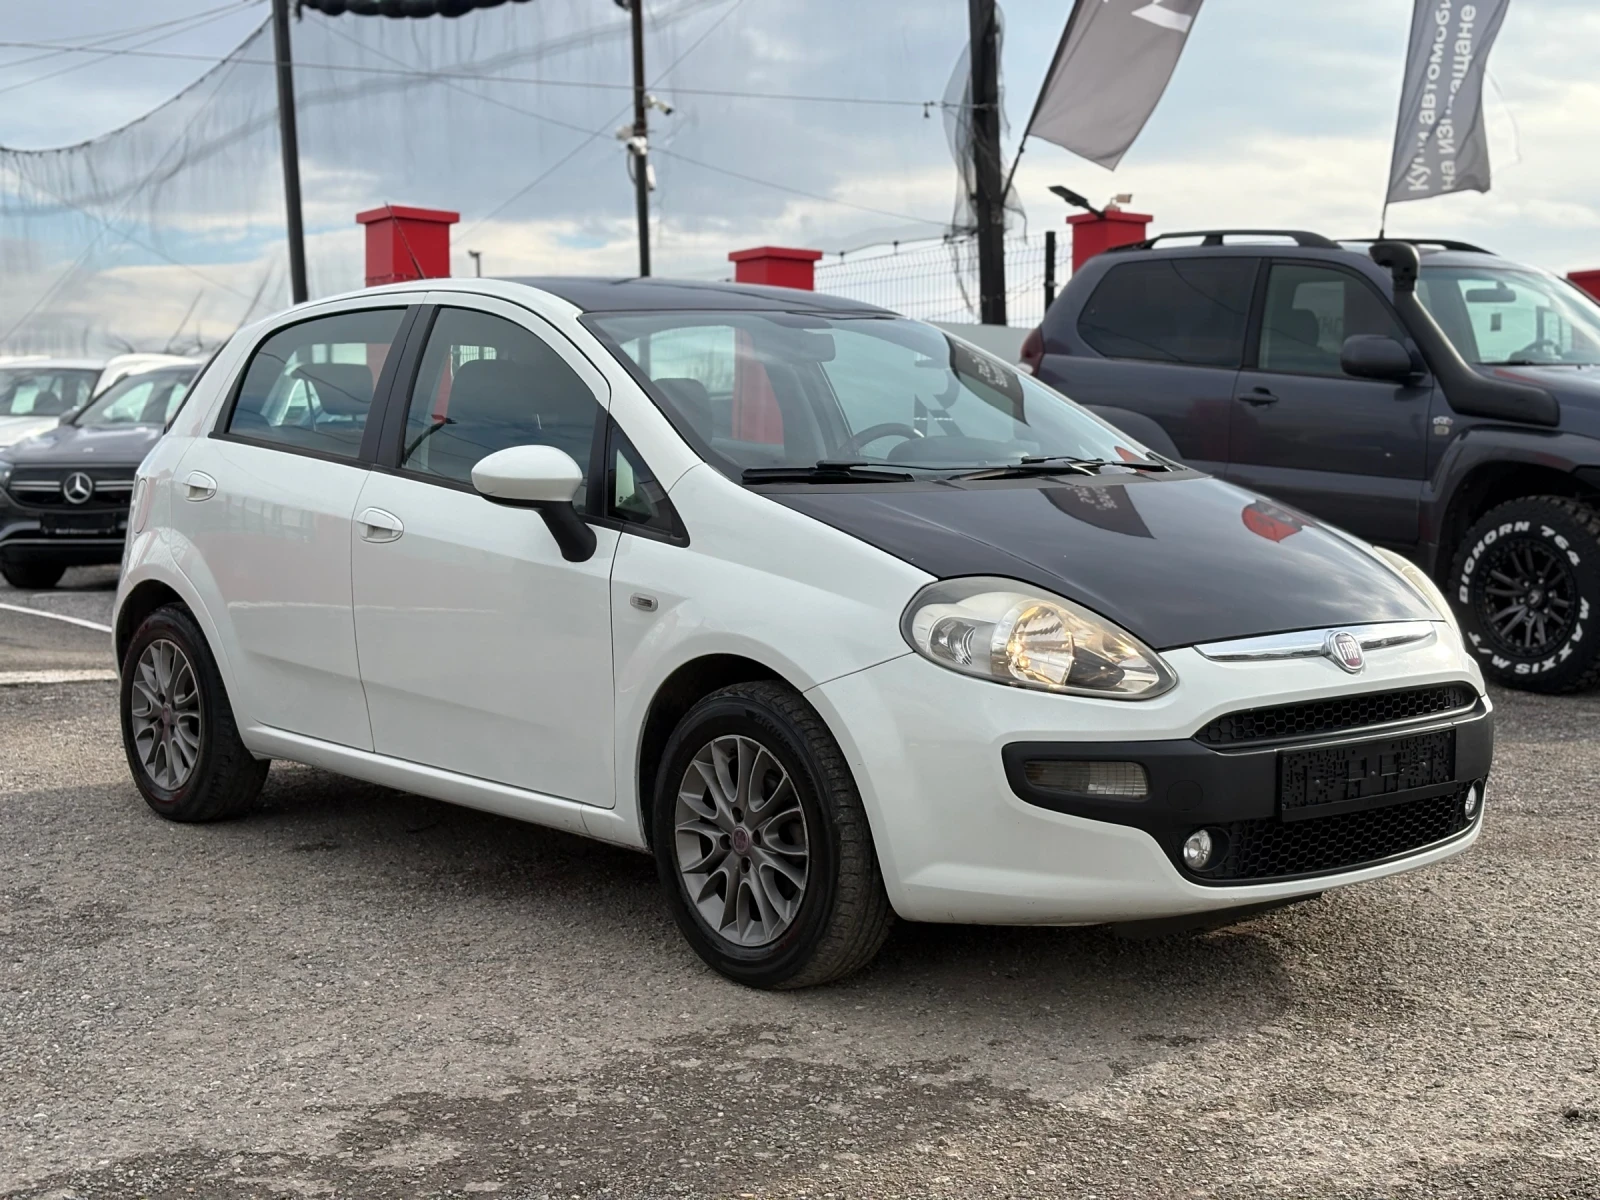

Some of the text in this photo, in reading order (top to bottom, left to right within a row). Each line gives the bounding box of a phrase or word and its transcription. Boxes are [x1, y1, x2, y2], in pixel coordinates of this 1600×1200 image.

[1436, 4, 1477, 190] на изащане
[1459, 521, 1581, 604] BIGHORN 764
[1514, 596, 1590, 674] MAXXIS
